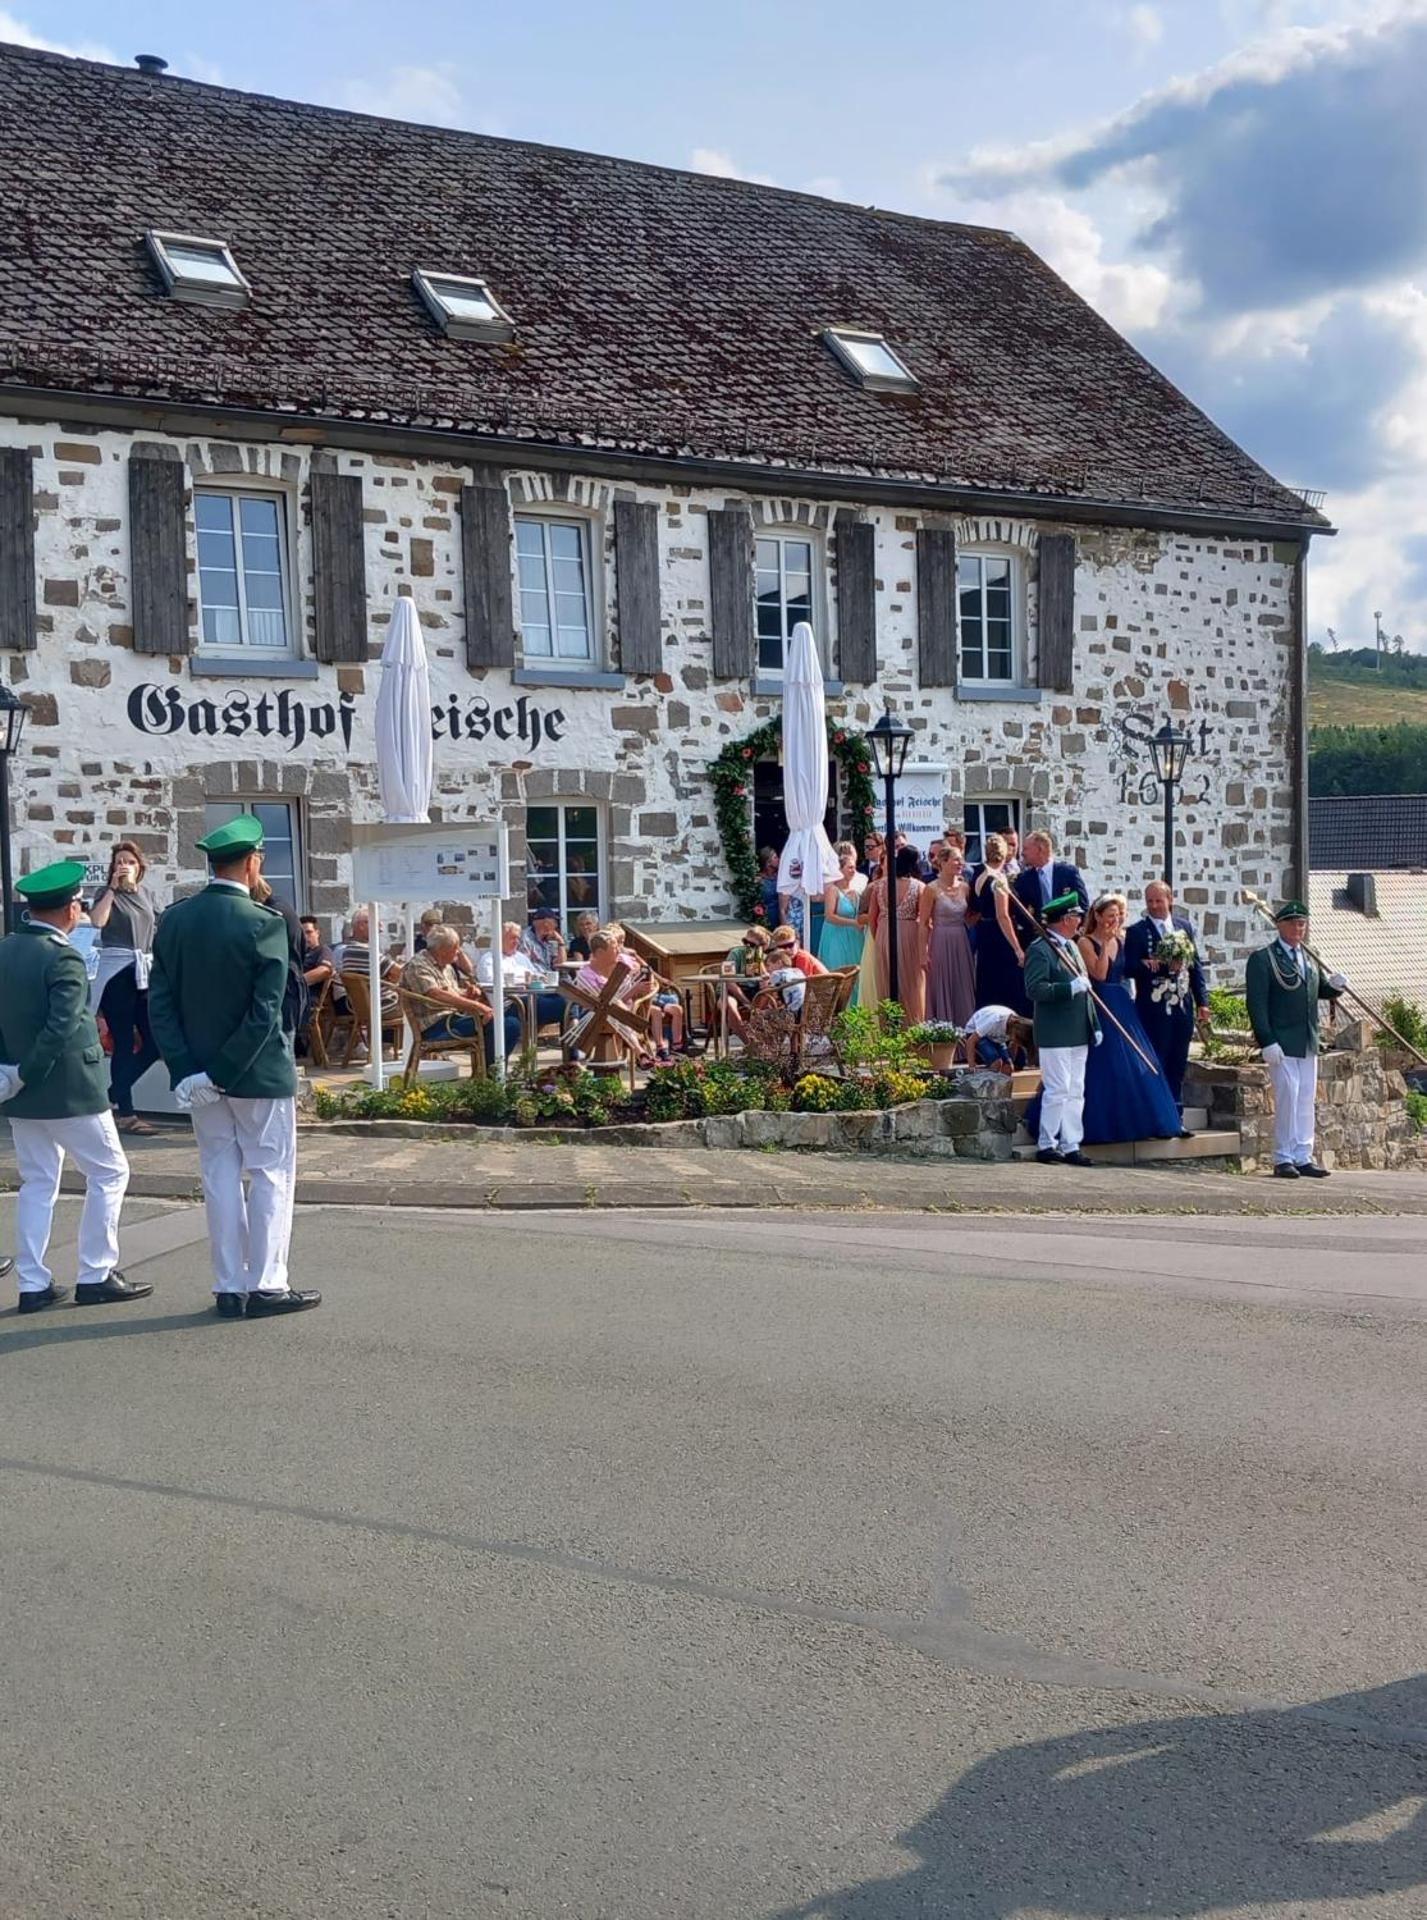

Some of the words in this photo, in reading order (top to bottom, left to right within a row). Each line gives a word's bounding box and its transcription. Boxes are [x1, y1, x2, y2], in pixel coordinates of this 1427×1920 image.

[127, 683, 356, 753] Gasthof
[431, 693, 566, 753] eische
[84, 865, 107, 874] KPL
